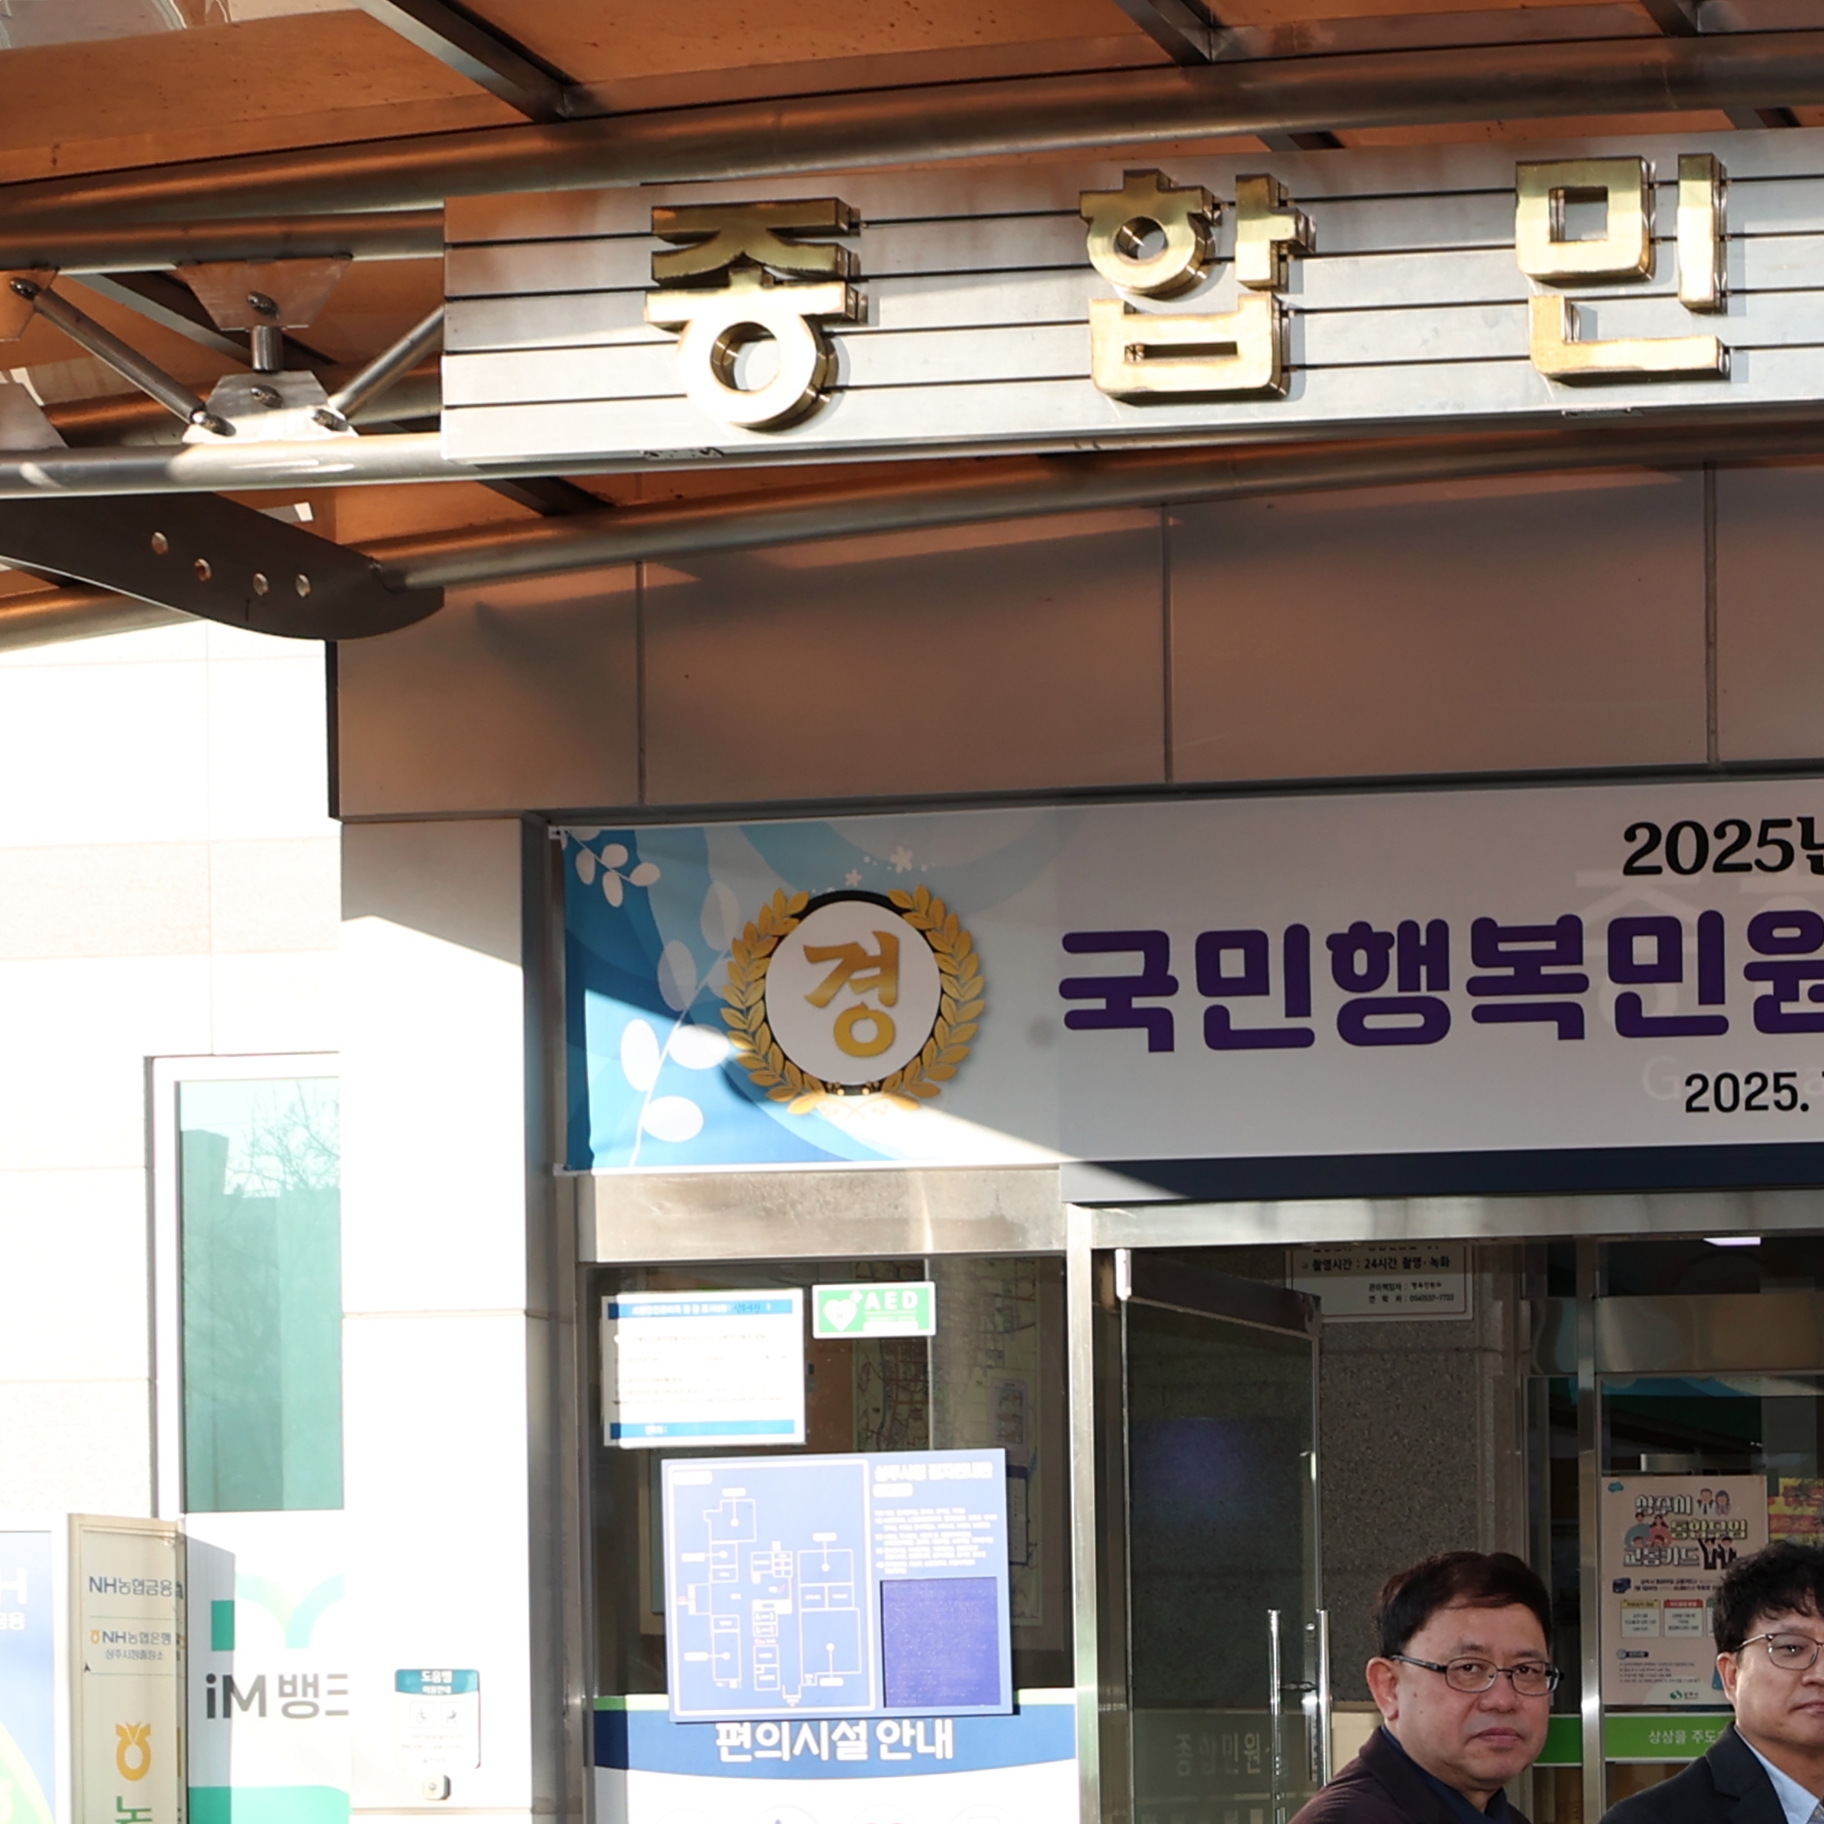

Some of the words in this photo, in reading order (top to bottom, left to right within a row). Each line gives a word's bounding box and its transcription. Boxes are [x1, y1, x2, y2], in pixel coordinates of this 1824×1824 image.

[803, 930, 899, 1058] 경
[1363, 1257, 1398, 1270] 24시간
[864, 1290, 919, 1310] AED
[88, 1575, 173, 1598] NH농협금융
[715, 1720, 870, 1763] 편의시설
[875, 1718, 954, 1761] 안내
[1648, 1729, 1687, 1746] 상상을
